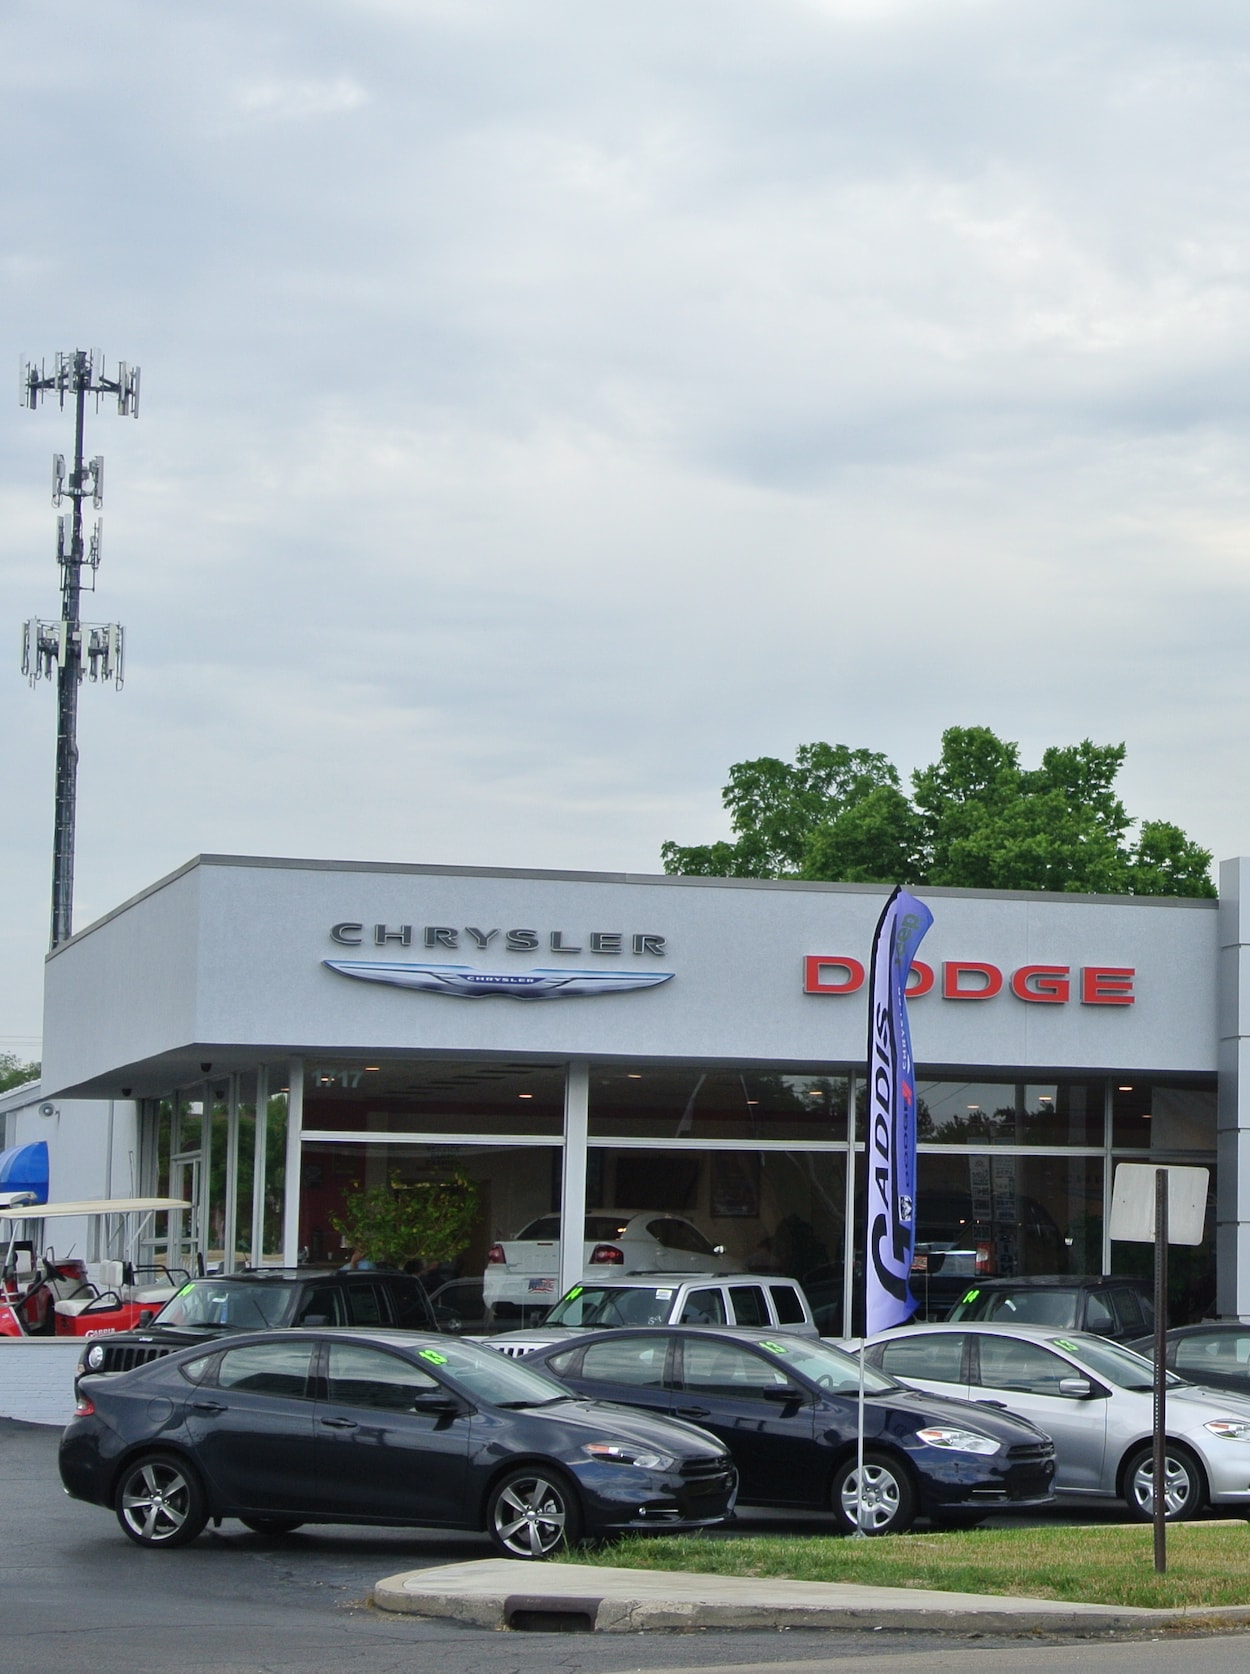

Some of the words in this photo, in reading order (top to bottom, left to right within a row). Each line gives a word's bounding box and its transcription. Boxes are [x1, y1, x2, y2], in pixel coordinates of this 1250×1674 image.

[329, 922, 669, 956] CHRYSLER
[466, 976, 534, 984] CHRYSLER
[311, 1068, 364, 1089] 1717
[758, 1341, 787, 1353] 13
[418, 1349, 448, 1365] 13
